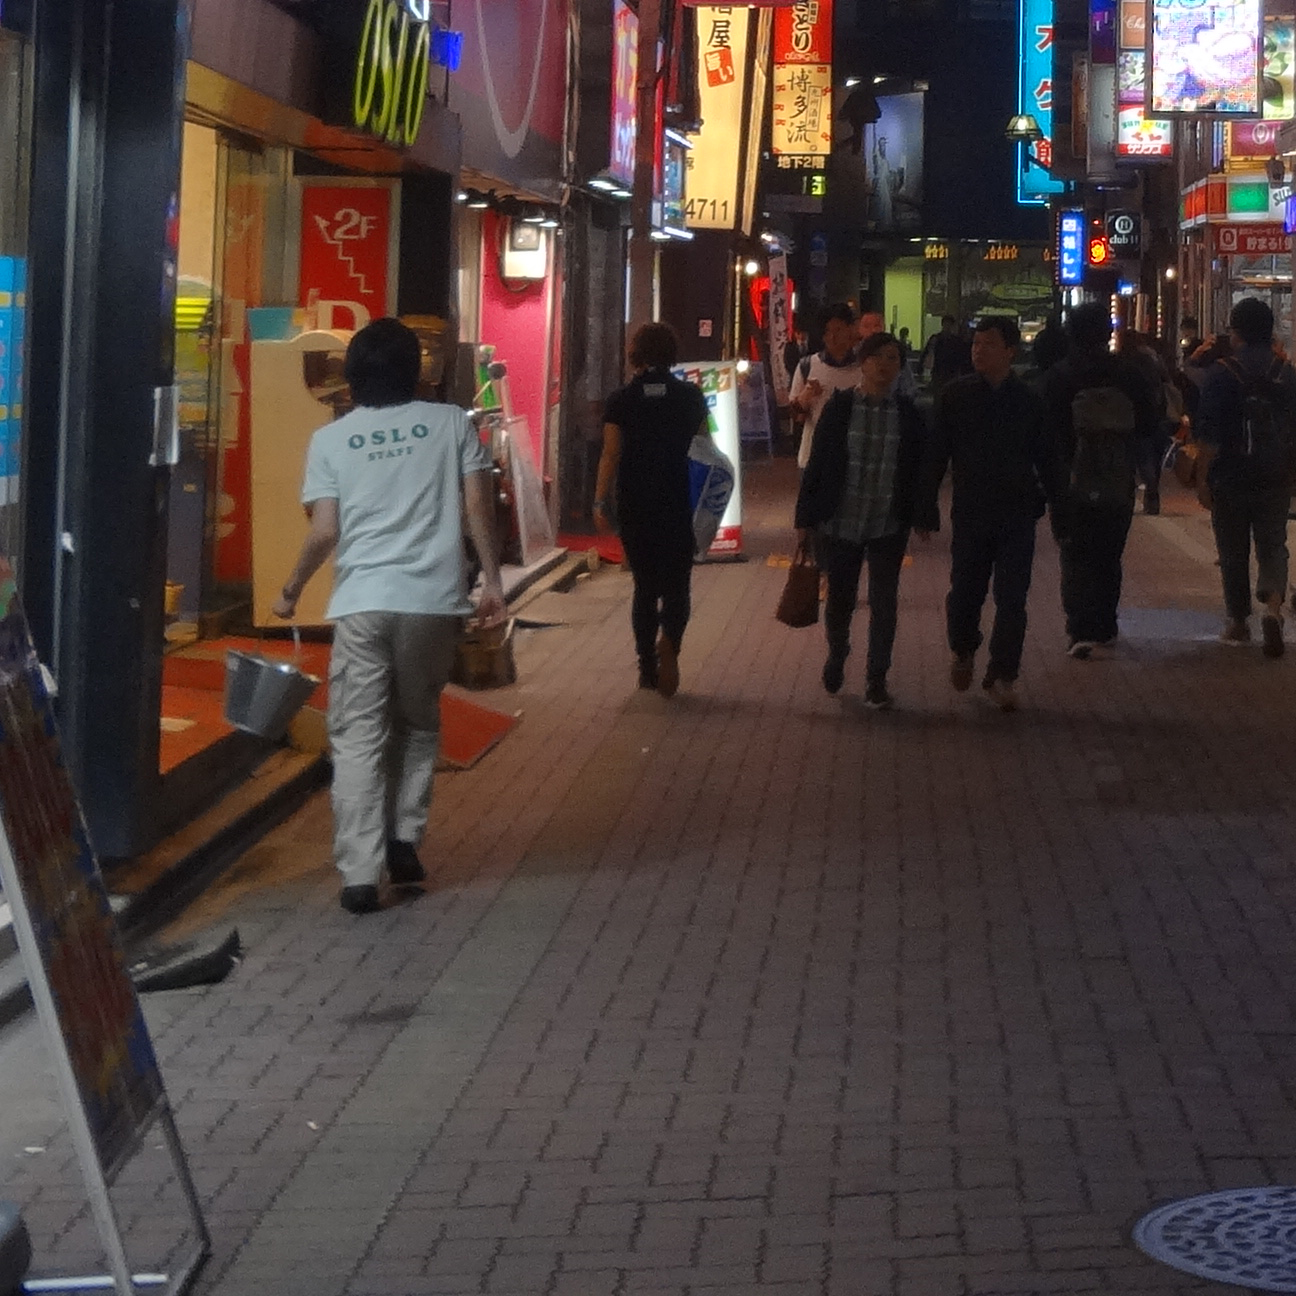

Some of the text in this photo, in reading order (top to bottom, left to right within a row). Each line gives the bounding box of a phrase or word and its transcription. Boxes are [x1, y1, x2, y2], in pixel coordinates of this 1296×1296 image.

[787, 68, 812, 144] 博多流
[777, 156, 825, 170] 地下2階
[349, 423, 429, 450] OSLO
[368, 445, 414, 462] STAFF
